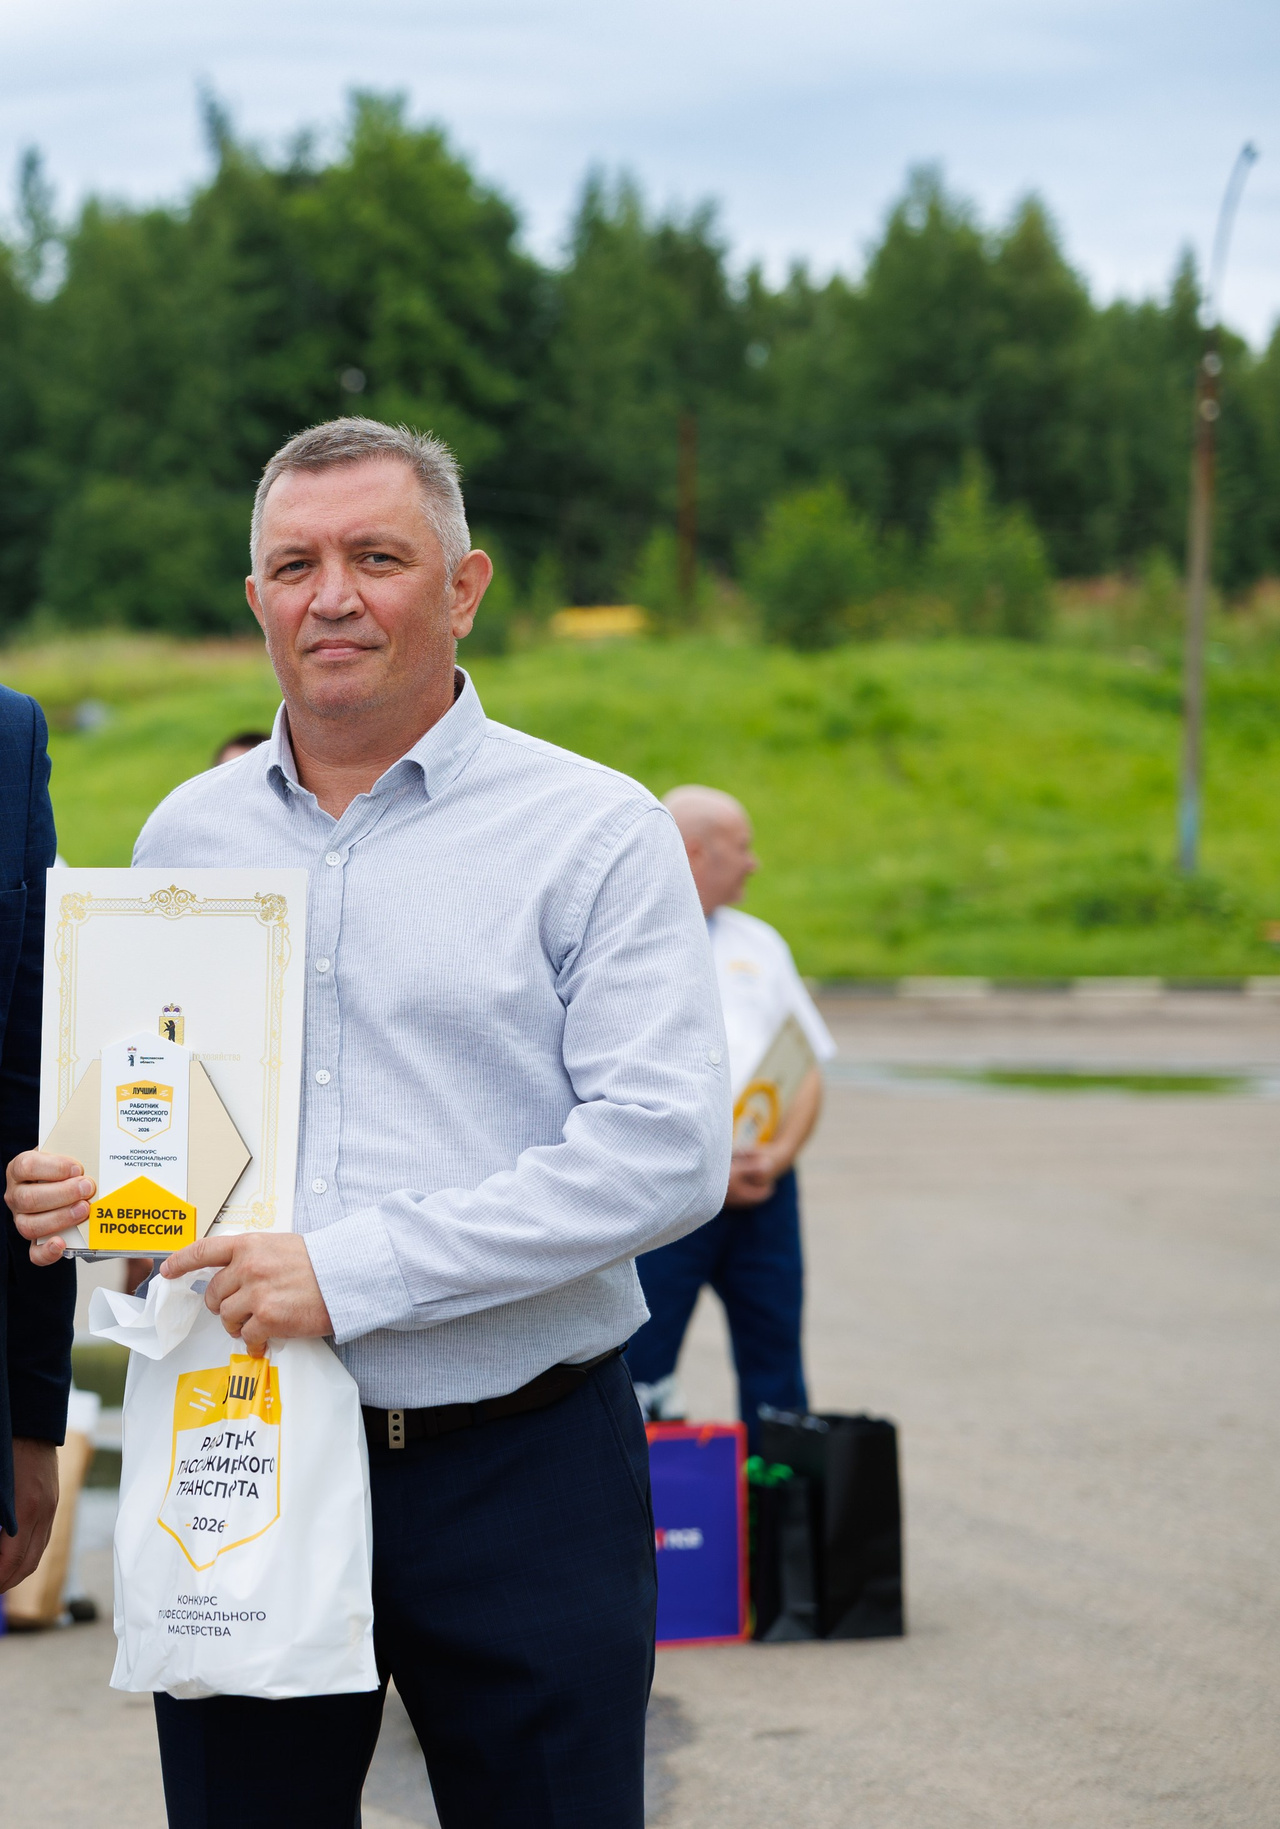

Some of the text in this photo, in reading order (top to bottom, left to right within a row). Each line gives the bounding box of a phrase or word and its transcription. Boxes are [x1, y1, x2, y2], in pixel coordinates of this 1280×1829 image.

[132, 1086, 157, 1095] ЛУЧШИЙ
[96, 1208, 187, 1221] ЗА ВЕРНОСТЬ
[99, 1223, 183, 1236] ПРОФЕССИИ
[192, 1516, 226, 1534] 2026
[177, 1594, 218, 1606] КОНКУРС
[167, 1624, 232, 1637] МАСТЕРСТВА
